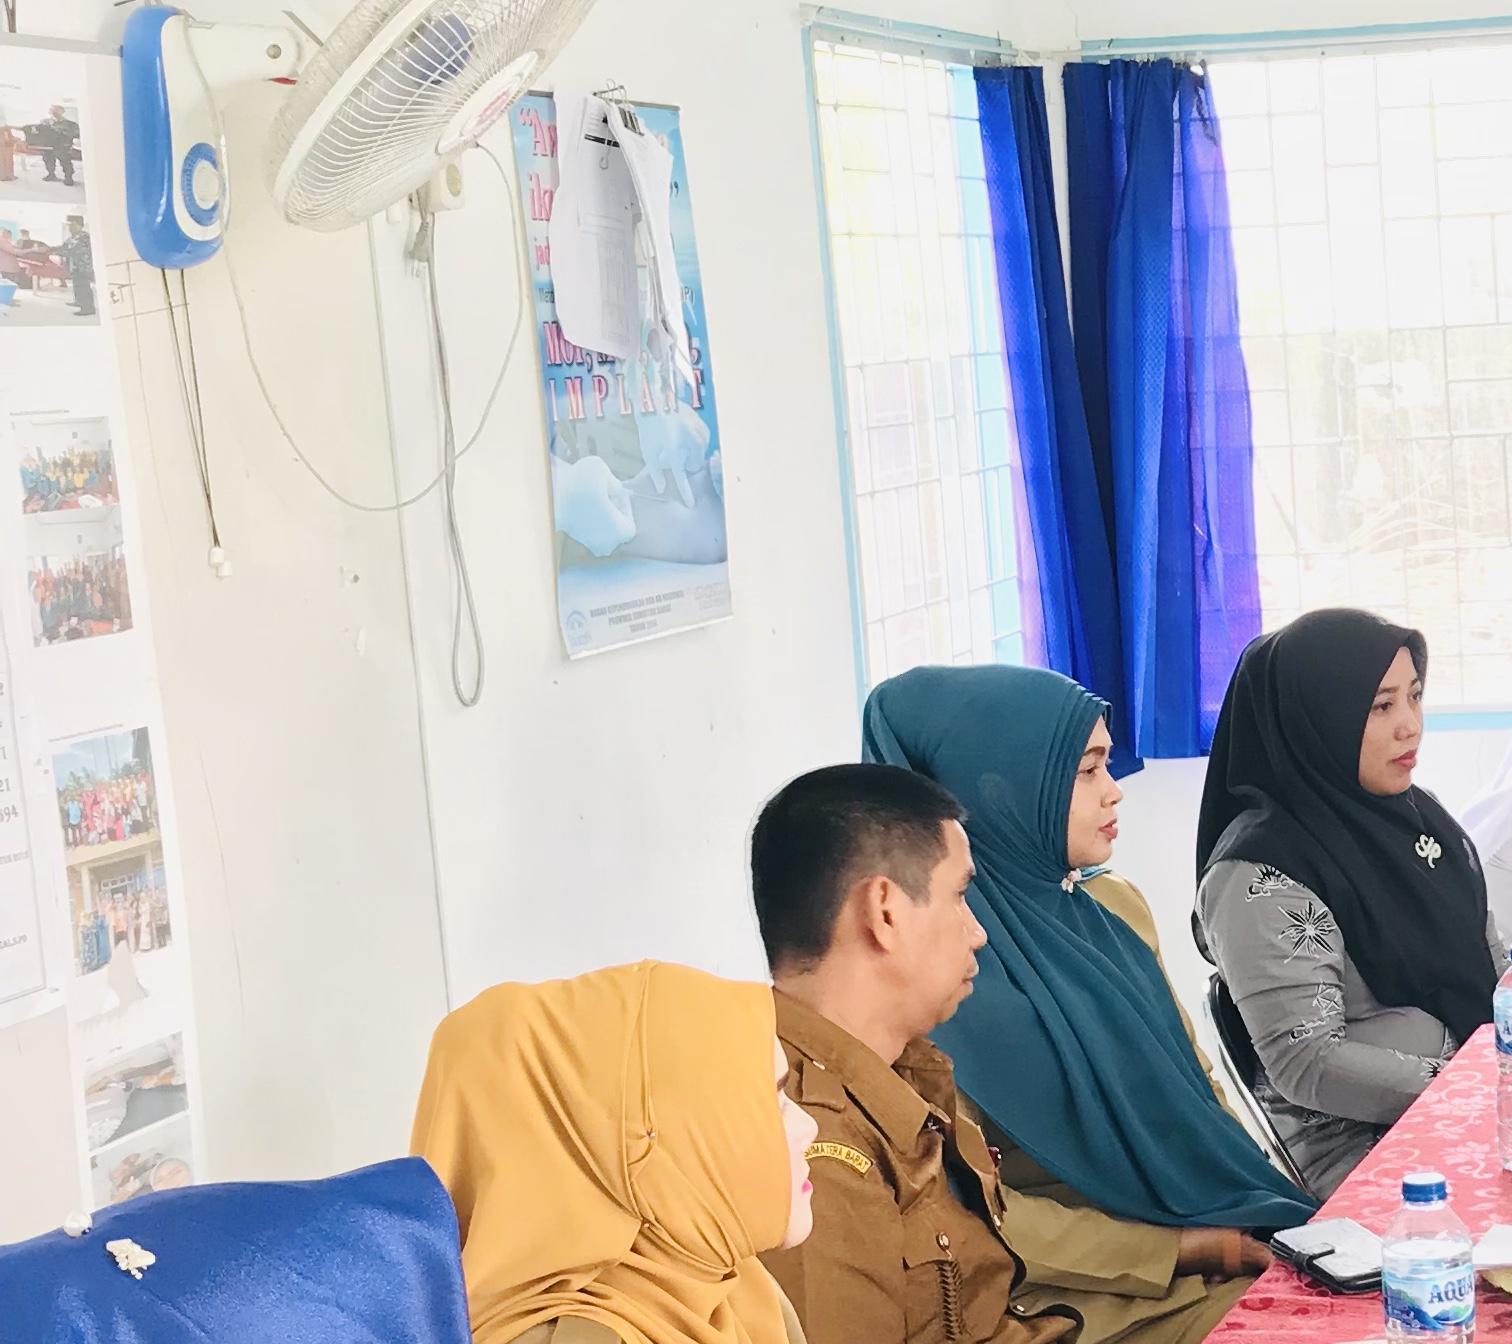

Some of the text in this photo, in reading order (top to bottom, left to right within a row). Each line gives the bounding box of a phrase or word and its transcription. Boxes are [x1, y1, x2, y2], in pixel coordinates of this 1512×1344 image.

[804, 1144, 869, 1170] SUMATERA BARAT
[1428, 1276, 1475, 1305] AQUA
